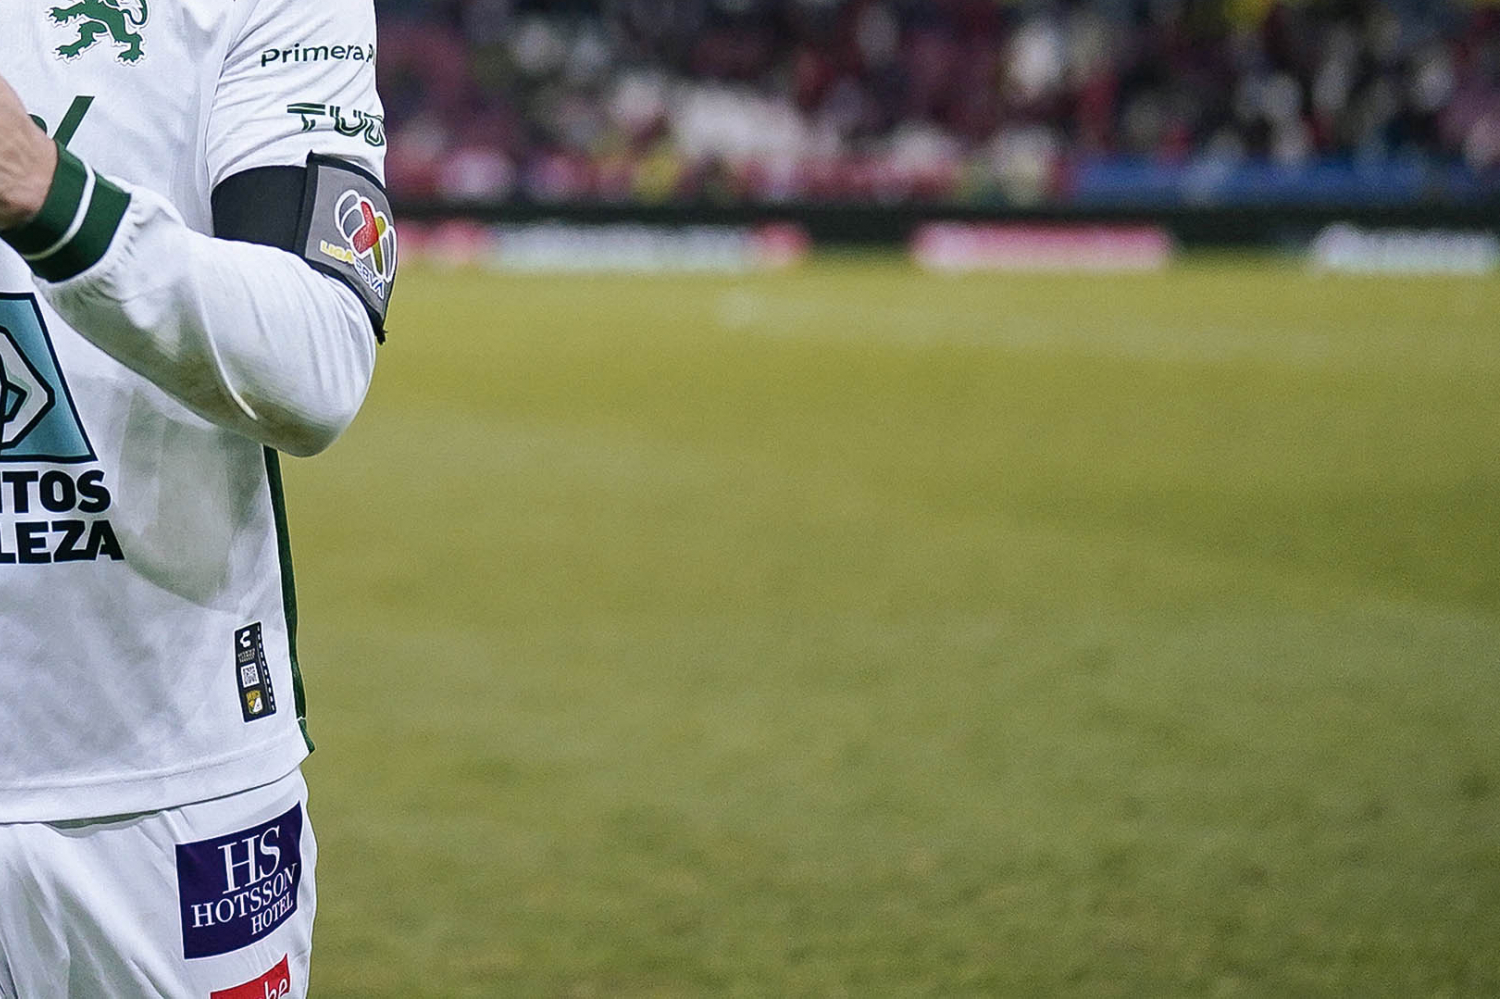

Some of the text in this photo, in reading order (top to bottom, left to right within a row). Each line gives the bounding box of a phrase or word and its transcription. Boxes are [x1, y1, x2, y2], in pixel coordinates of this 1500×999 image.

[261, 43, 365, 67] Primera
[320, 240, 355, 264] LIGA
[218, 825, 281, 894] HS
[191, 863, 298, 928] HOTSSON
[251, 891, 294, 935] HOTEL
